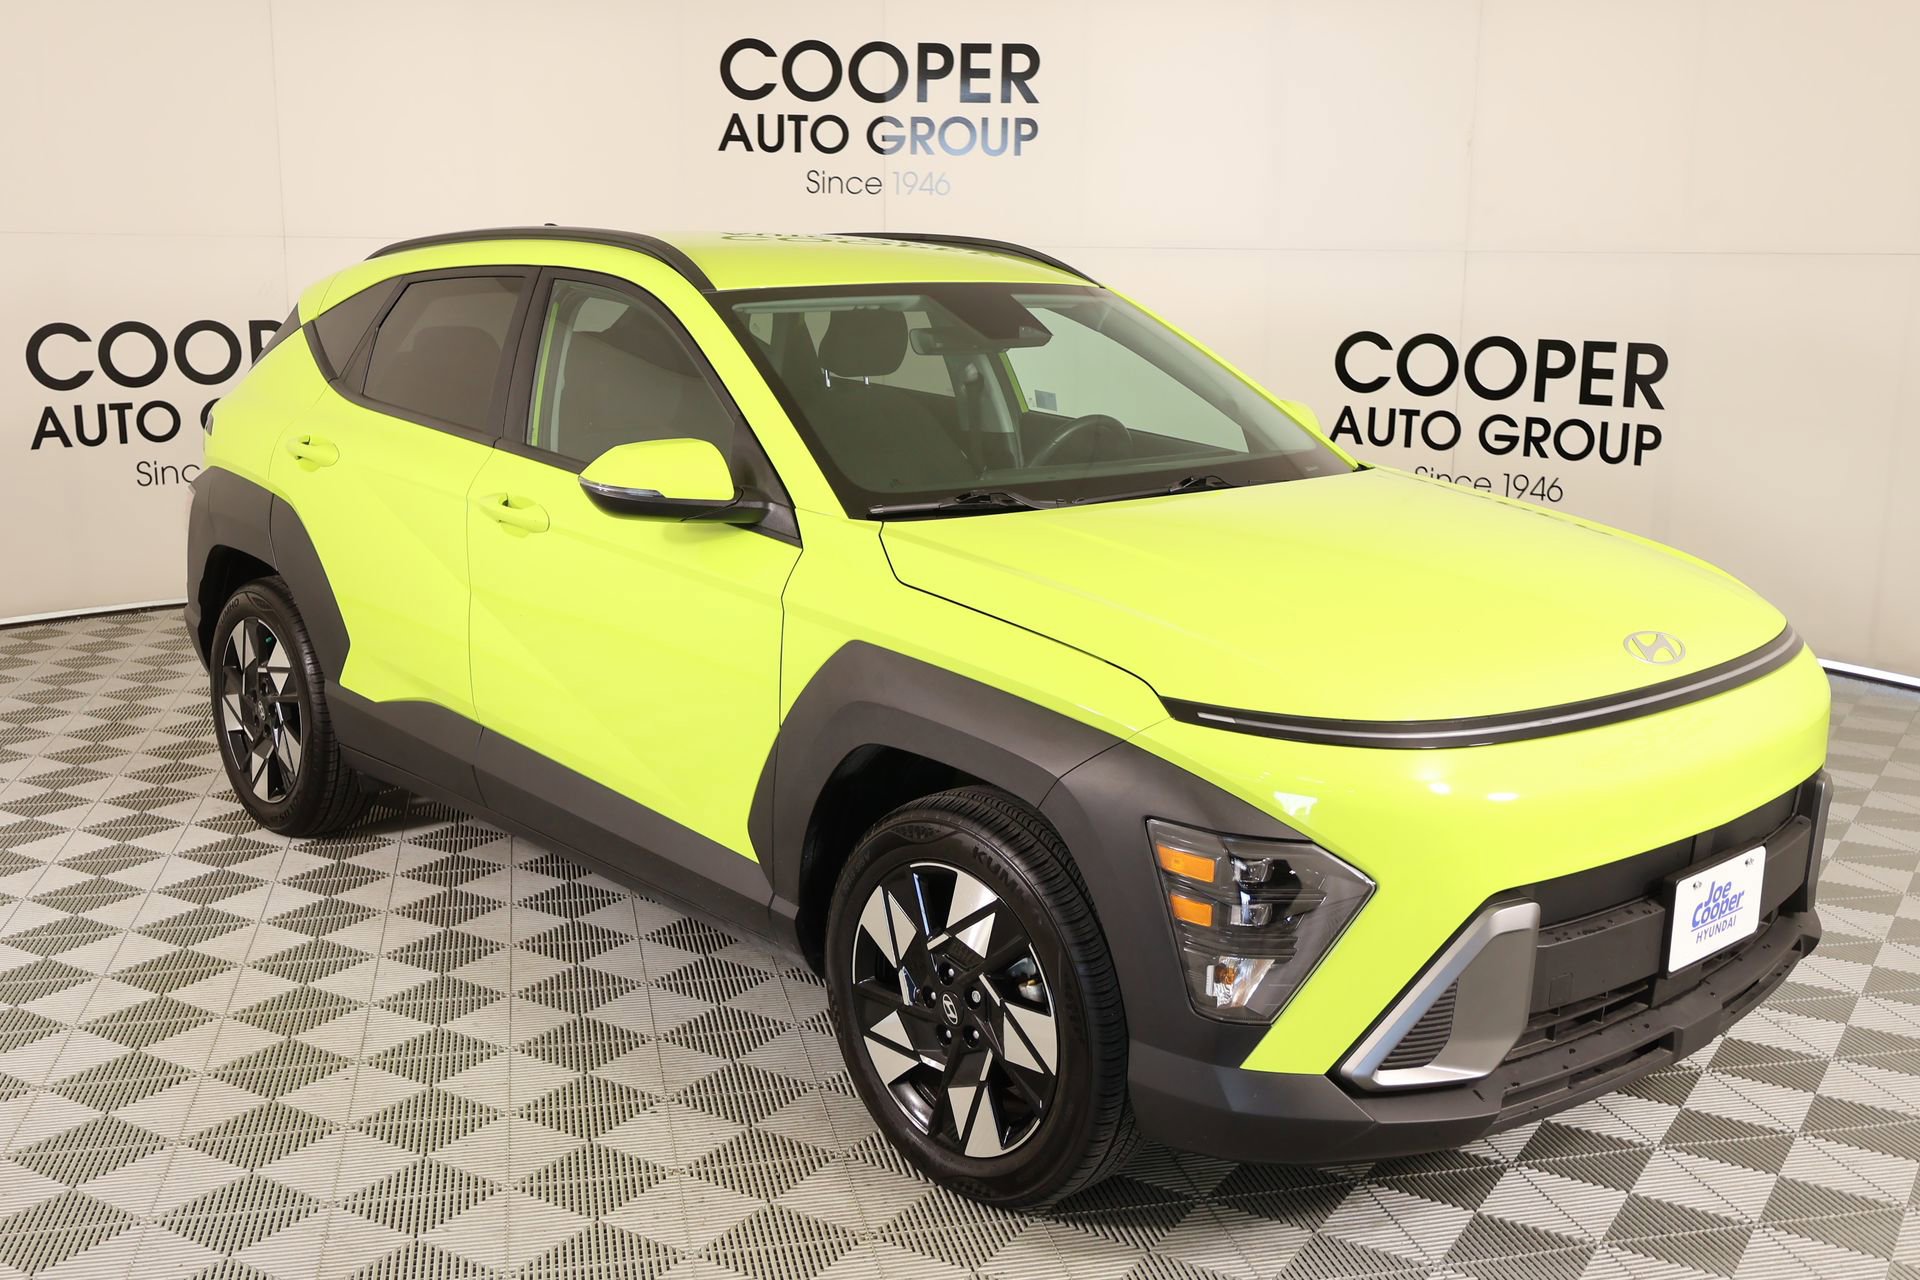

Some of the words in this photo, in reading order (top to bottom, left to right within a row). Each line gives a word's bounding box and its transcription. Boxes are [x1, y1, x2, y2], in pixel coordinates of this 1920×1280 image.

[720, 37, 1041, 104] COOPER
[718, 113, 850, 155] AUTO
[866, 115, 1039, 157] GROUP
[806, 169, 883, 195] Since
[891, 171, 951, 196] 1946
[1334, 330, 1669, 411] COOPER
[30, 400, 182, 451] AUTO
[1329, 405, 1462, 451] AUTO
[1478, 413, 1663, 467] GROUP
[136, 460, 201, 487] Sinc
[1502, 472, 1564, 503] 1946
[1691, 890, 1745, 929] Cooper
[1703, 880, 1732, 908] Joe
[1695, 915, 1737, 945] HYUNDAI
